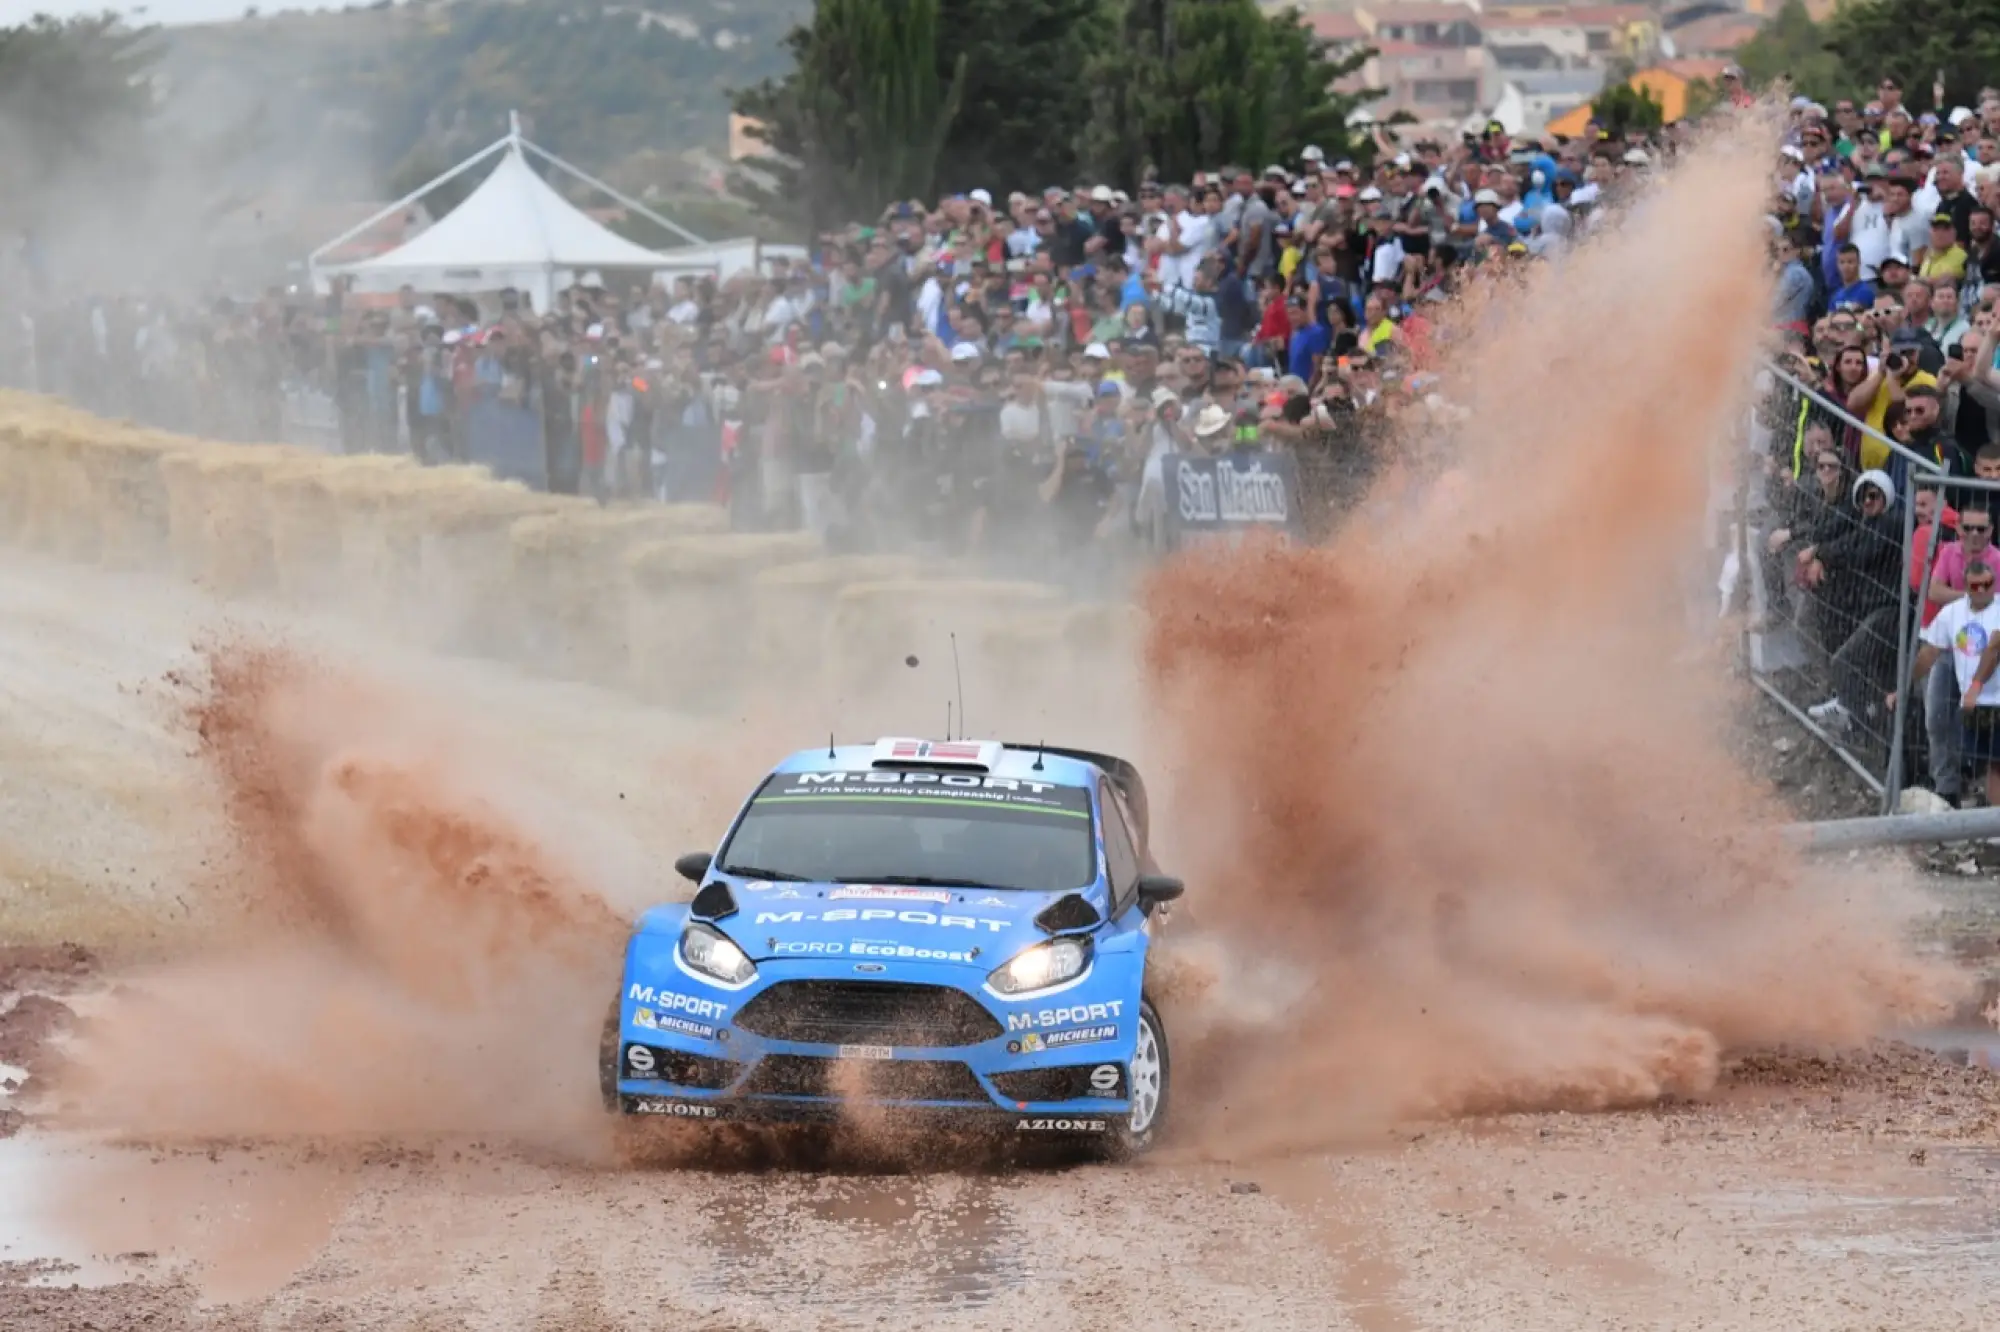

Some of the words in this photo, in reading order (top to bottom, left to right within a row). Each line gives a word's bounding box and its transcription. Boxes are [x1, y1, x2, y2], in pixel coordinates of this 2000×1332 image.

[1178, 460, 1217, 520] San
[1217, 459, 1288, 521] Martino
[797, 772, 1056, 793] M-SPORT
[917, 788, 1004, 800] Championship
[755, 908, 1012, 932] M-SPORT
[774, 942, 844, 954] FORD
[849, 941, 976, 963] EcoBoost
[629, 983, 728, 1020] M-SPORT
[1007, 999, 1123, 1031] M-SPORT
[660, 1016, 712, 1036] MICHELIN
[1046, 1025, 1115, 1044] MICHELIN
[636, 1101, 717, 1117] AZIONE
[1015, 1119, 1106, 1131] AZIONE
